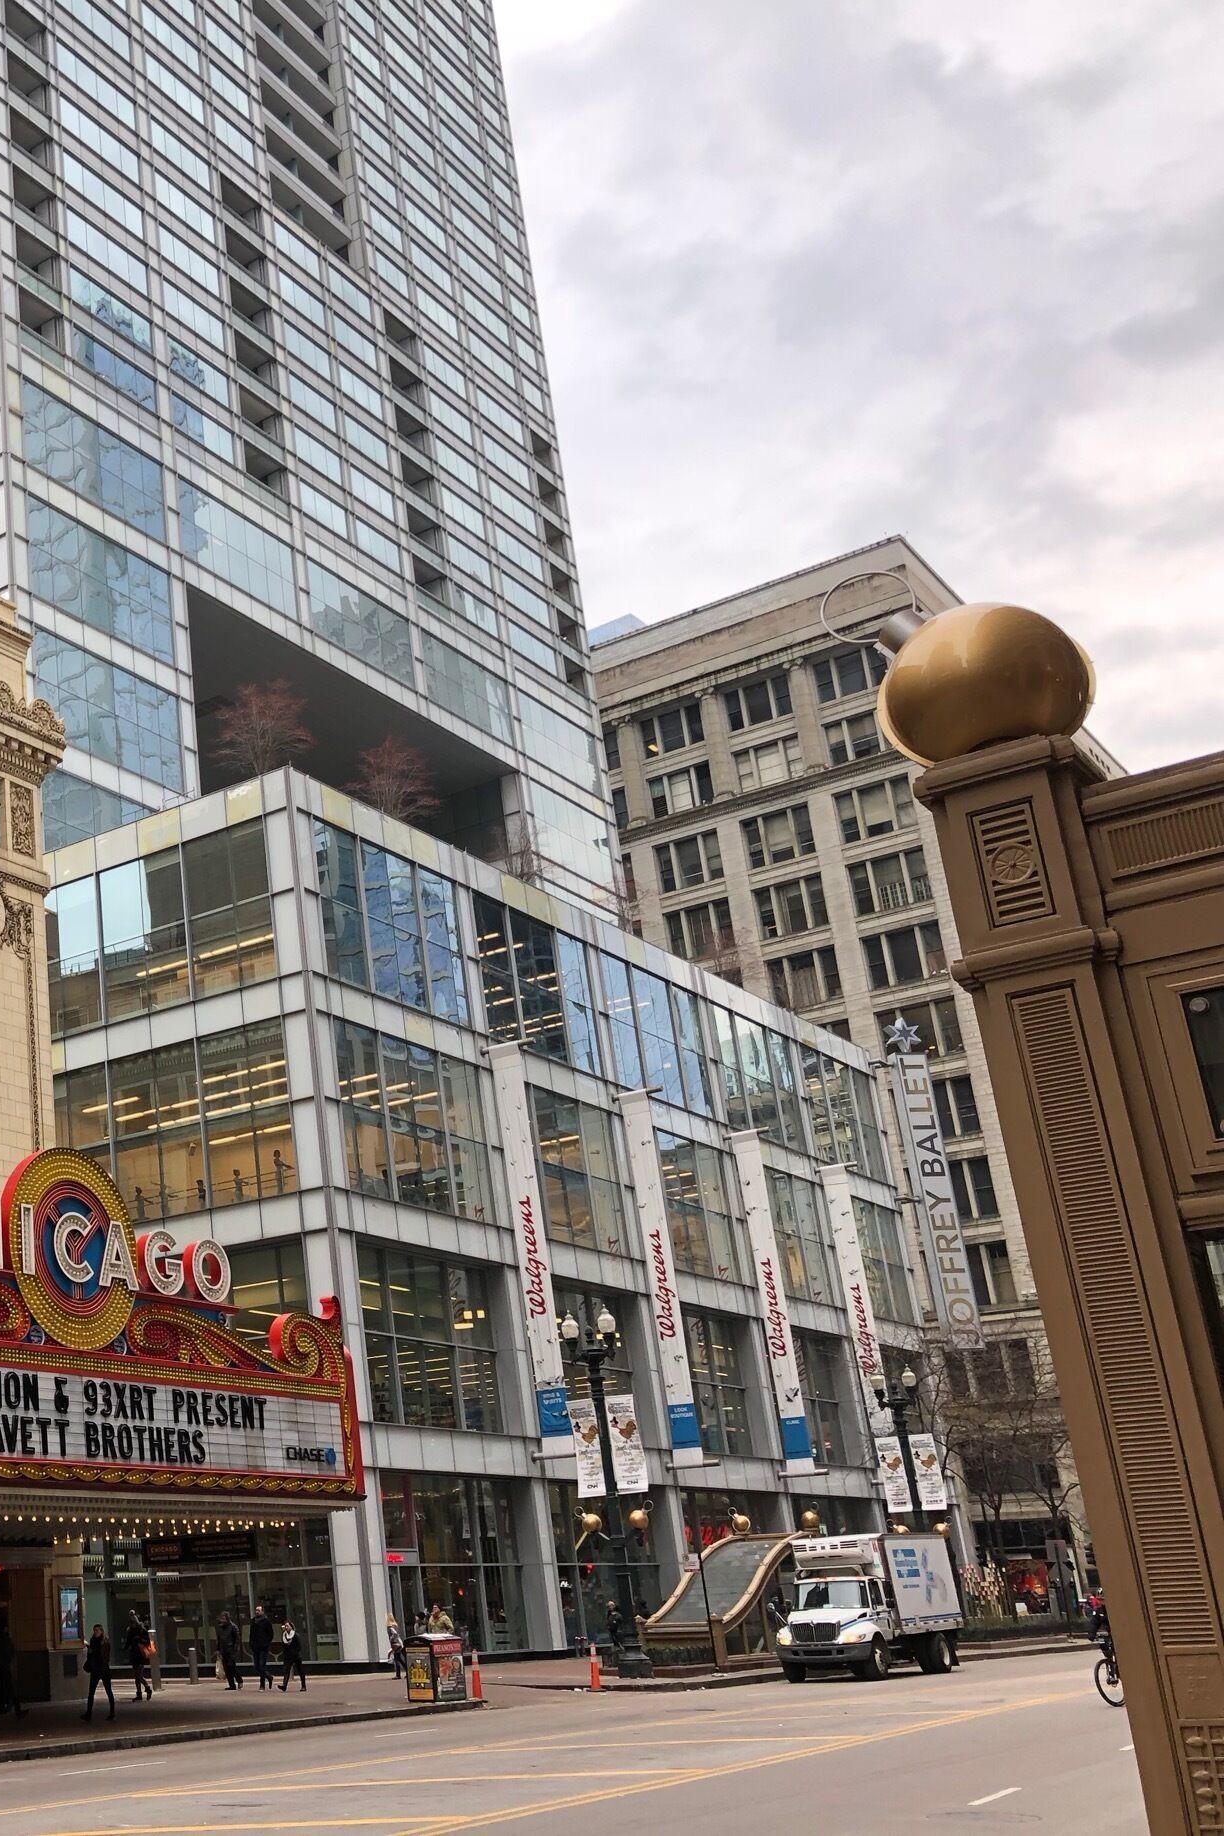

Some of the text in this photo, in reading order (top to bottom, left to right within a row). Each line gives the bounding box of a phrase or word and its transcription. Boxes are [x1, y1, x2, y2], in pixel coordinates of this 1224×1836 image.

[899, 1057, 980, 1347] JOFFREY BALLET
[519, 1195, 547, 1319] Walgreens
[649, 1229, 676, 1341] Walgreens
[761, 1258, 787, 1360] Walgreens
[850, 1283, 878, 1377] Walgreens
[54, 1376, 70, 1414] &
[84, 1379, 157, 1421] 93XRT
[172, 1388, 267, 1430] PRESENT
[84, 1421, 206, 1464] BROTHERS
[286, 1446, 325, 1462] CHASE
